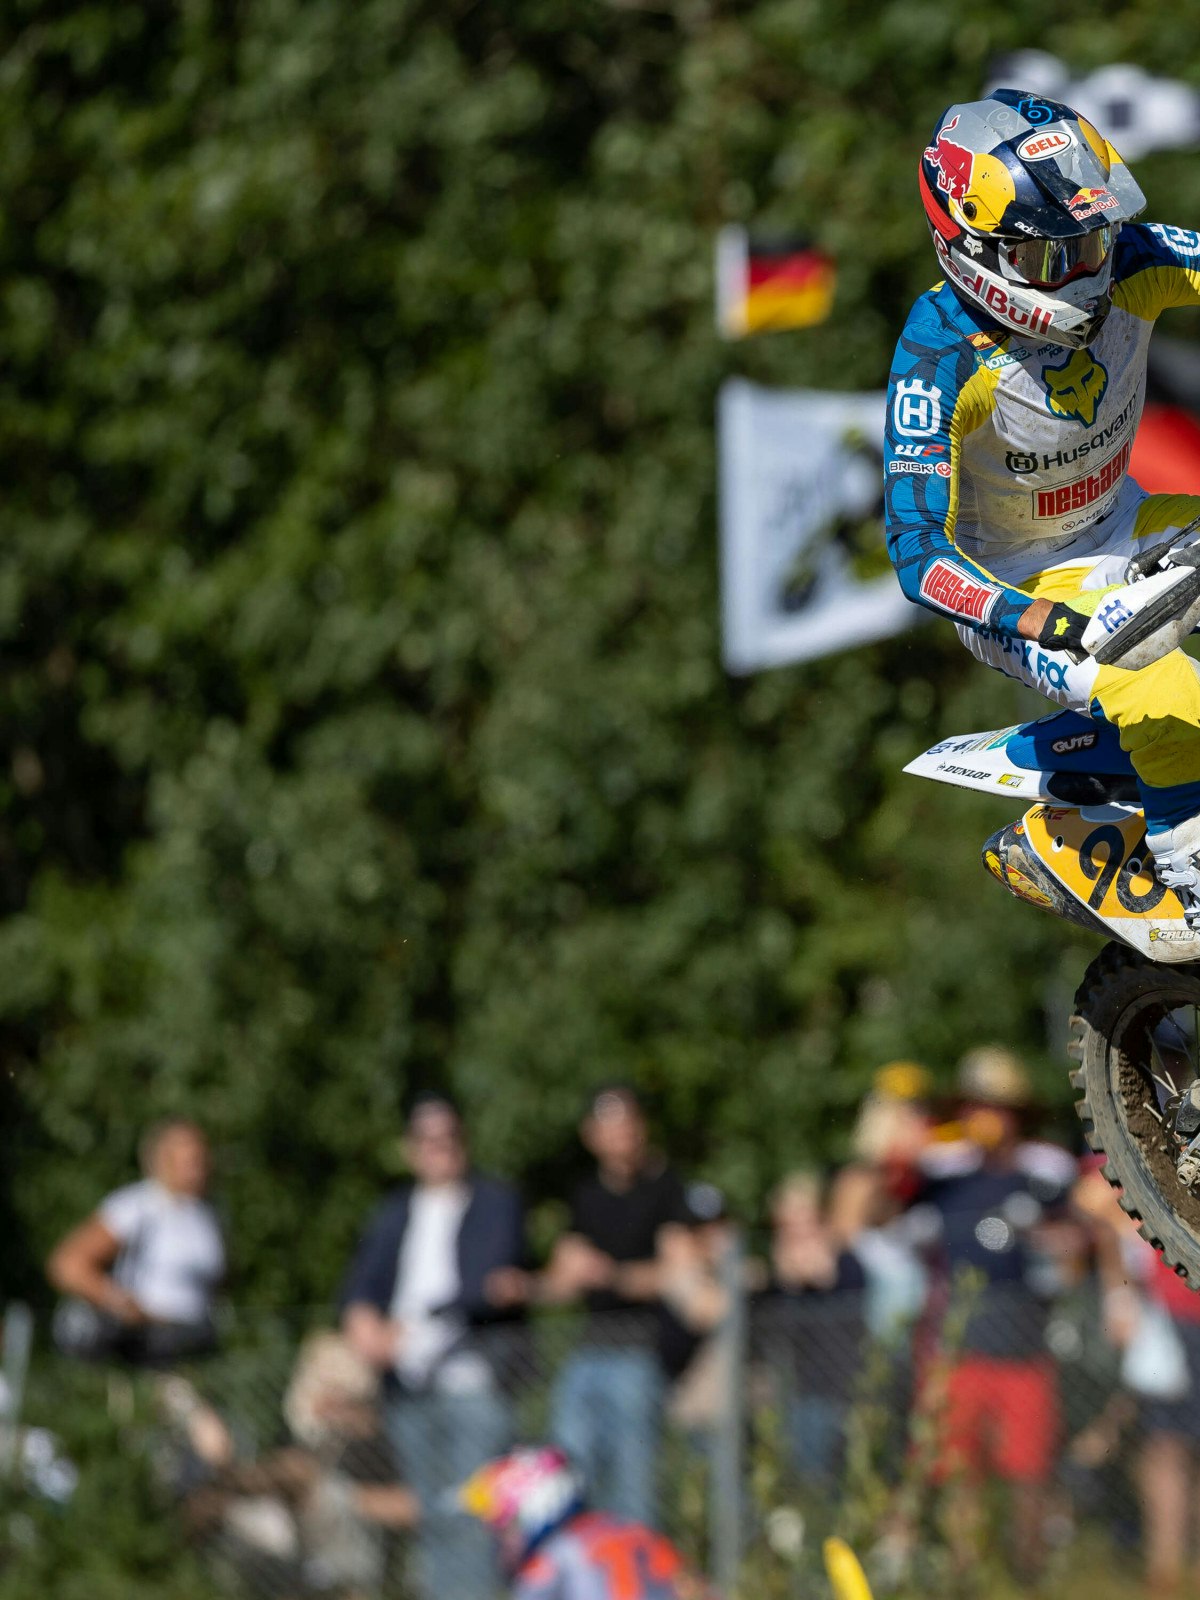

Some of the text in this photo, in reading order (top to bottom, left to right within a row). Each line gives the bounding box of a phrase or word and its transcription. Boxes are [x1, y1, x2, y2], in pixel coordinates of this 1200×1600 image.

[1025, 135, 1066, 157] BELL
[895, 444, 945, 457] WP
[890, 462, 933, 475] BRISK
[1037, 440, 1130, 517] nestaan
[922, 564, 993, 620] nestaan
[1036, 651, 1070, 692] FOX
[1052, 734, 1095, 753] GUTS
[944, 765, 992, 780] DUNLOP
[1079, 825, 1169, 915] 96
